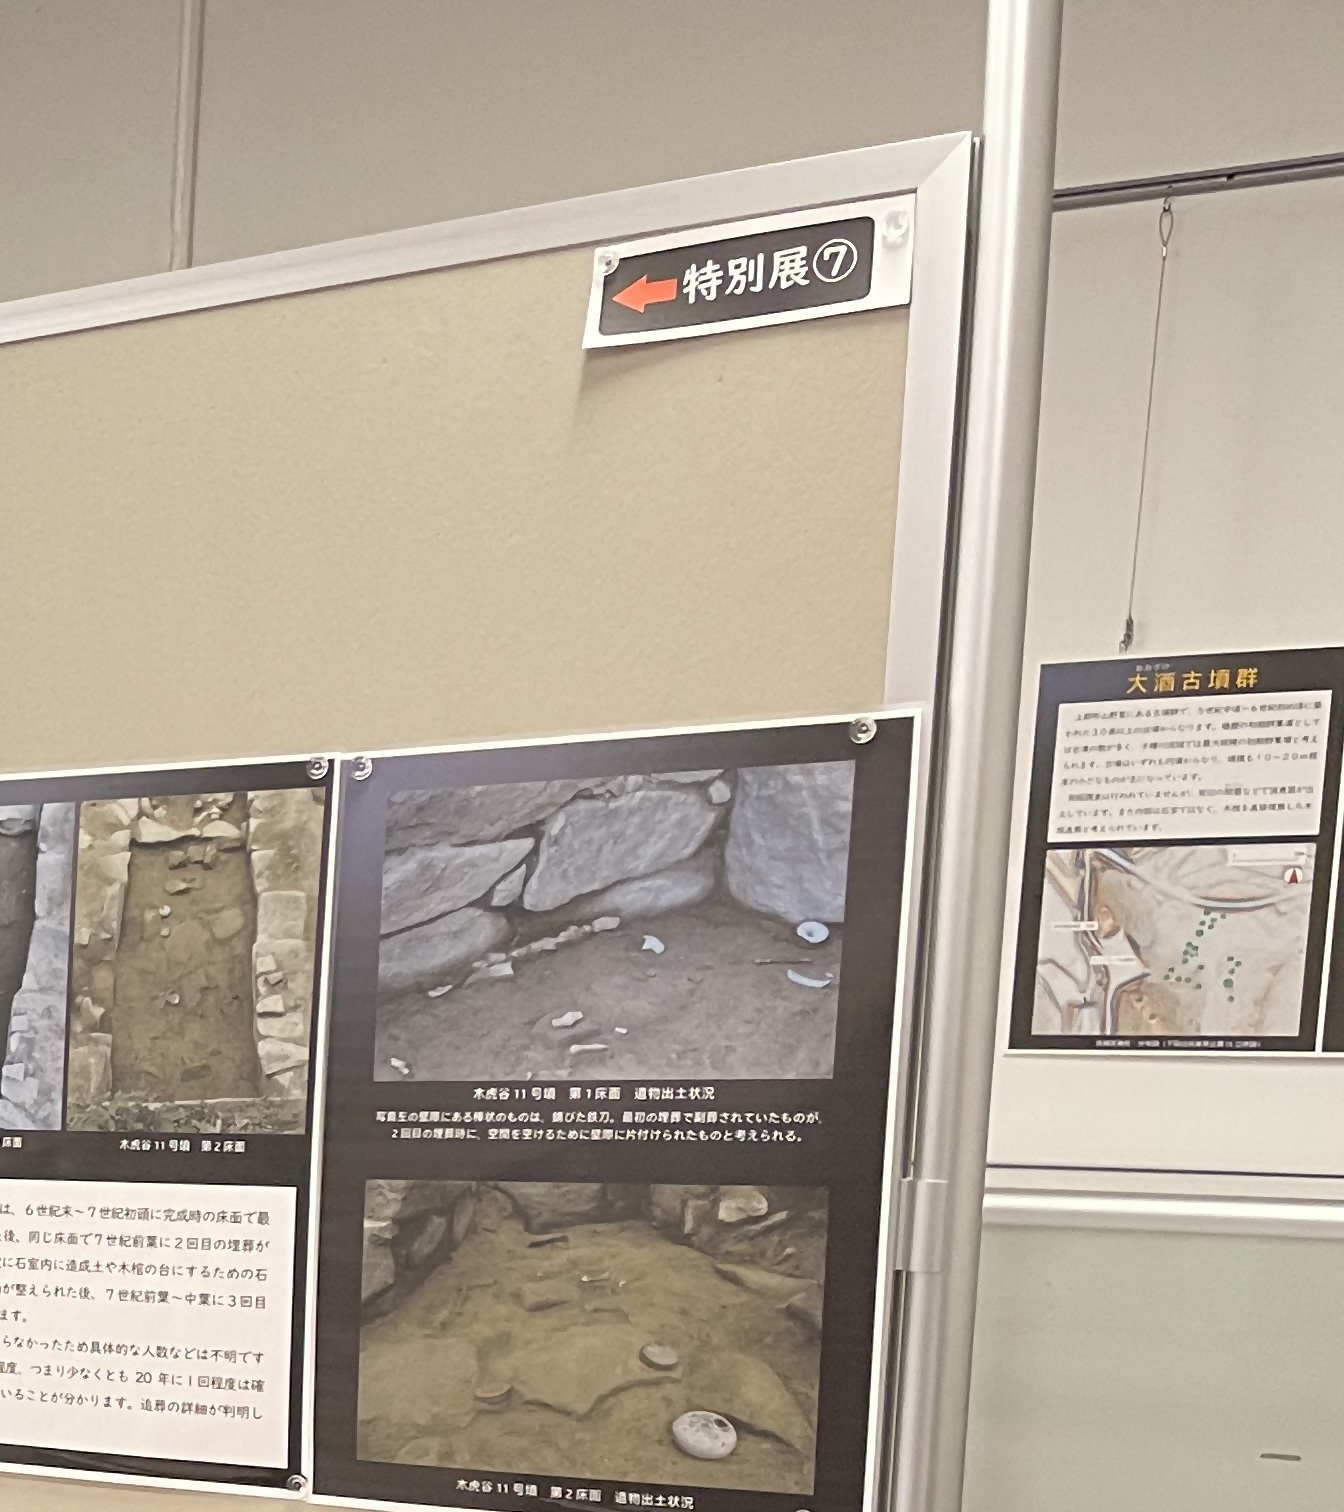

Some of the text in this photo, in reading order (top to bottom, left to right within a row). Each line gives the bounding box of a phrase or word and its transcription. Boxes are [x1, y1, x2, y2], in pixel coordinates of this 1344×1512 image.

[682, 238, 858, 304] 特別展⑦
[1126, 667, 1259, 696] 大酒古墳群
